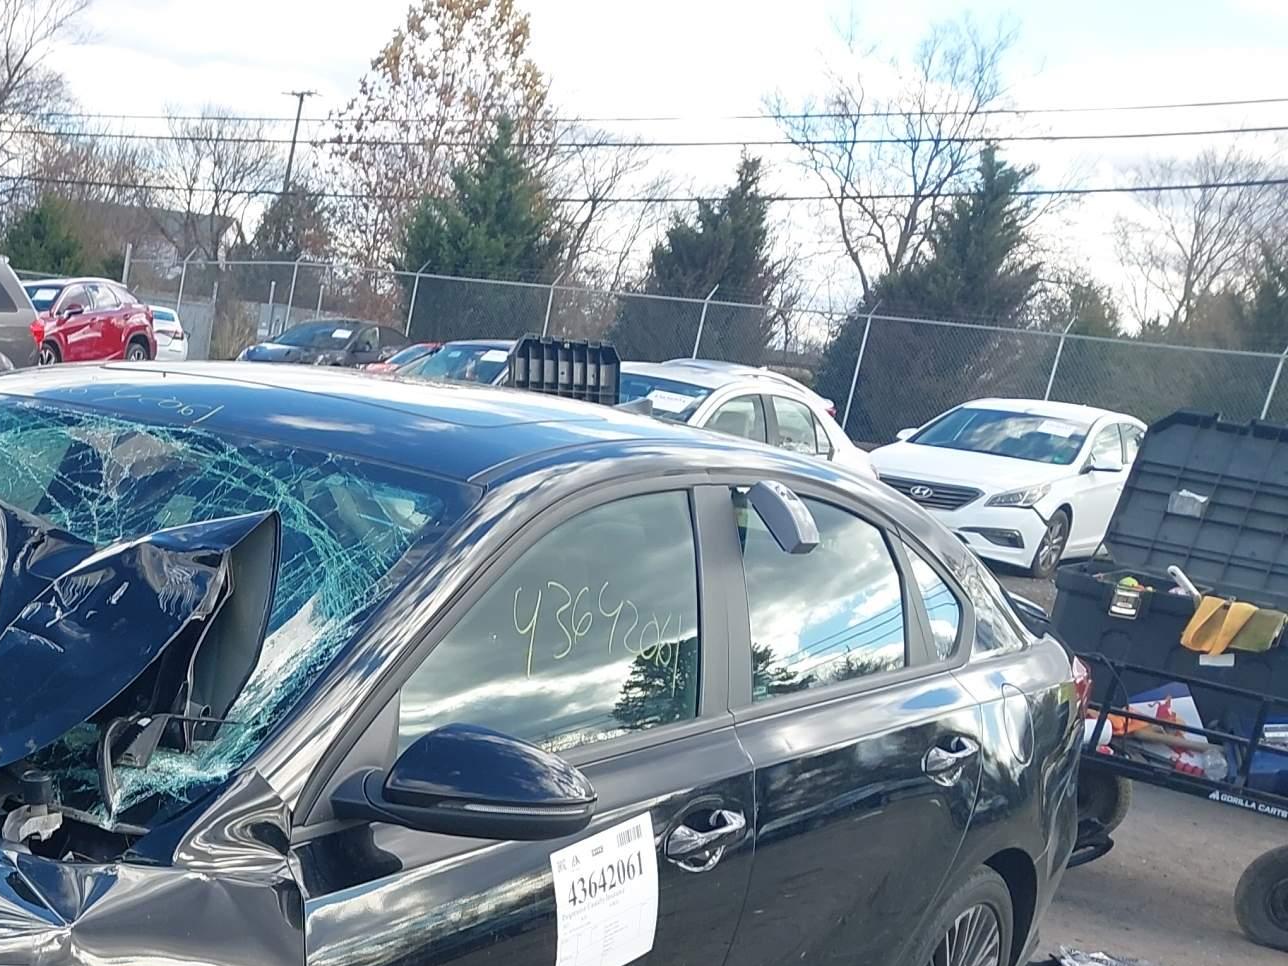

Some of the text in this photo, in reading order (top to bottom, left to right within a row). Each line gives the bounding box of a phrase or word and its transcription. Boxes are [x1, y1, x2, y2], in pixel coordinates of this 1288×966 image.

[513, 580, 682, 698] 43642061
[1220, 793, 1257, 810] GORILLA
[568, 850, 644, 907] 43642061
